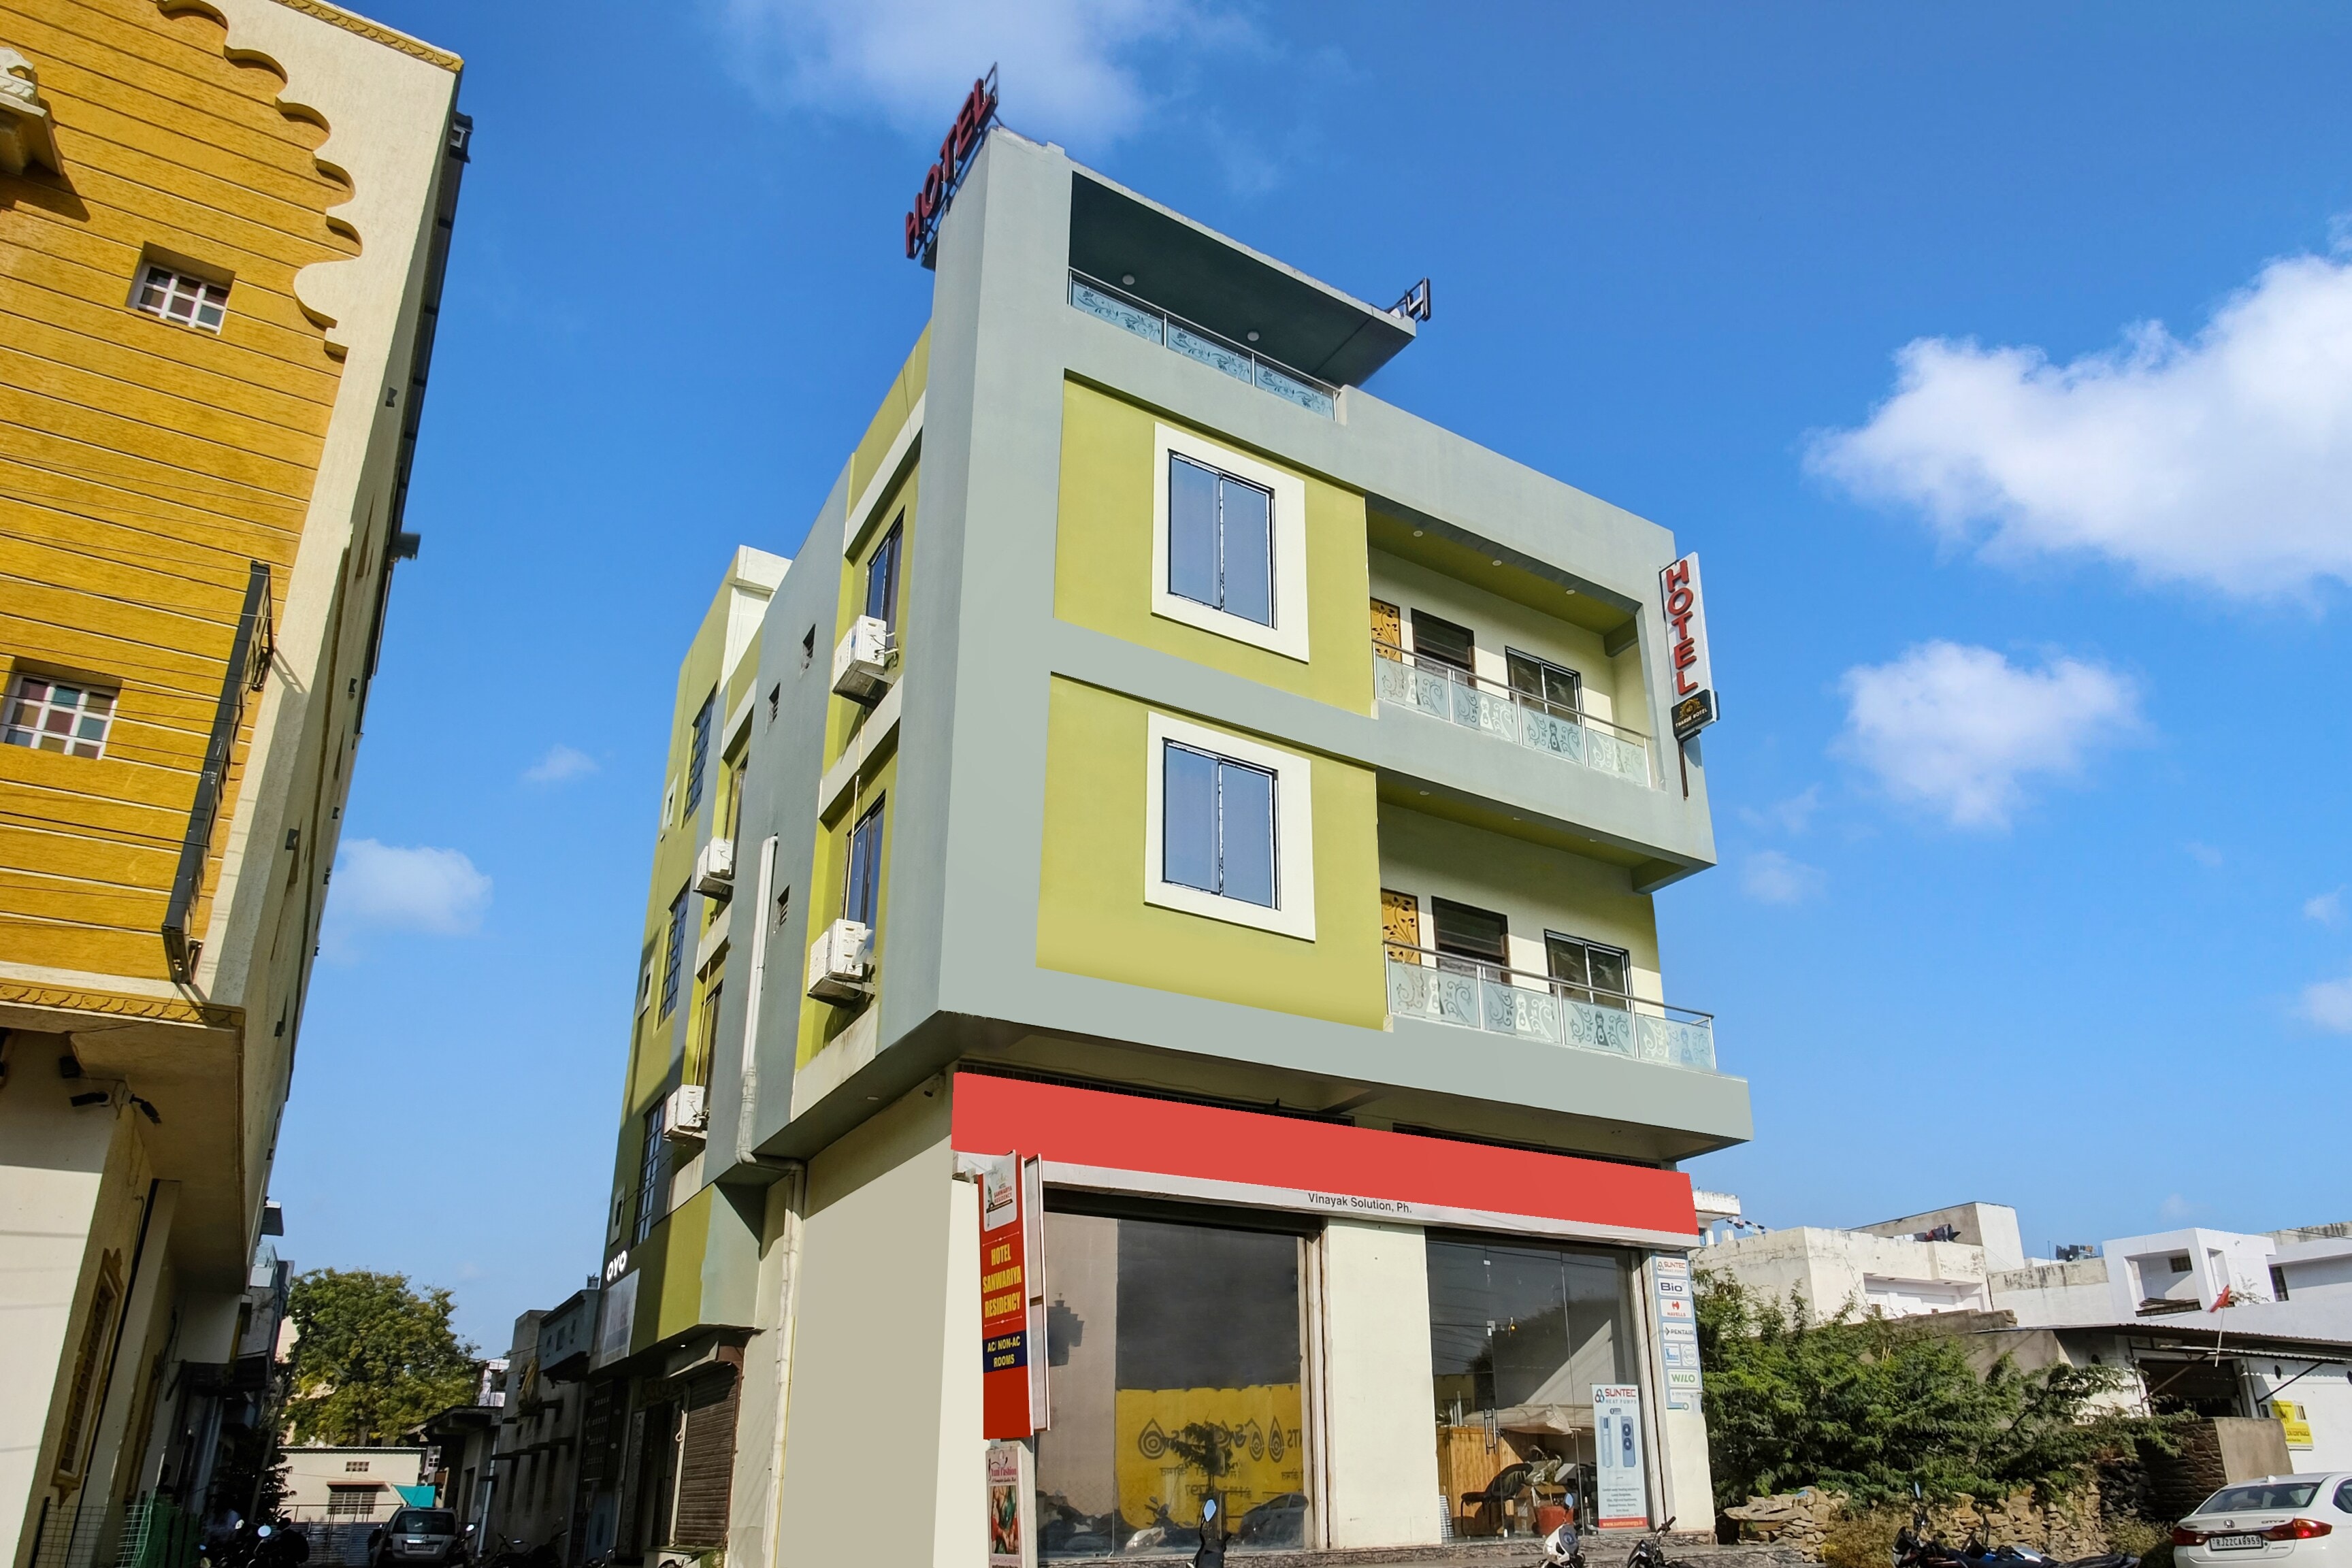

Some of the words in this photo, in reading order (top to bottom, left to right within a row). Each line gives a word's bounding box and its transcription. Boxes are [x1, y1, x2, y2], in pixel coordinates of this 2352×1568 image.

[906, 78, 996, 259] HOTEL
[1666, 559, 1698, 696] HOTEL
[1308, 1192, 1348, 1208] Vinayak
[1351, 1196, 1394, 1213] Solution,
[1396, 1202, 1412, 1213] Ph.
[991, 1243, 1011, 1266] HOTEL
[606, 1250, 628, 1283] OYO
[983, 1265, 1022, 1294] SANWARIYA
[1661, 1282, 1682, 1292] Bio
[985, 1292, 1021, 1318] RESIDENCY
[994, 1354, 1015, 1367] ROOMS
[1671, 1374, 1695, 1383] WILO
[1605, 1388, 1636, 1397] SUNTEC
